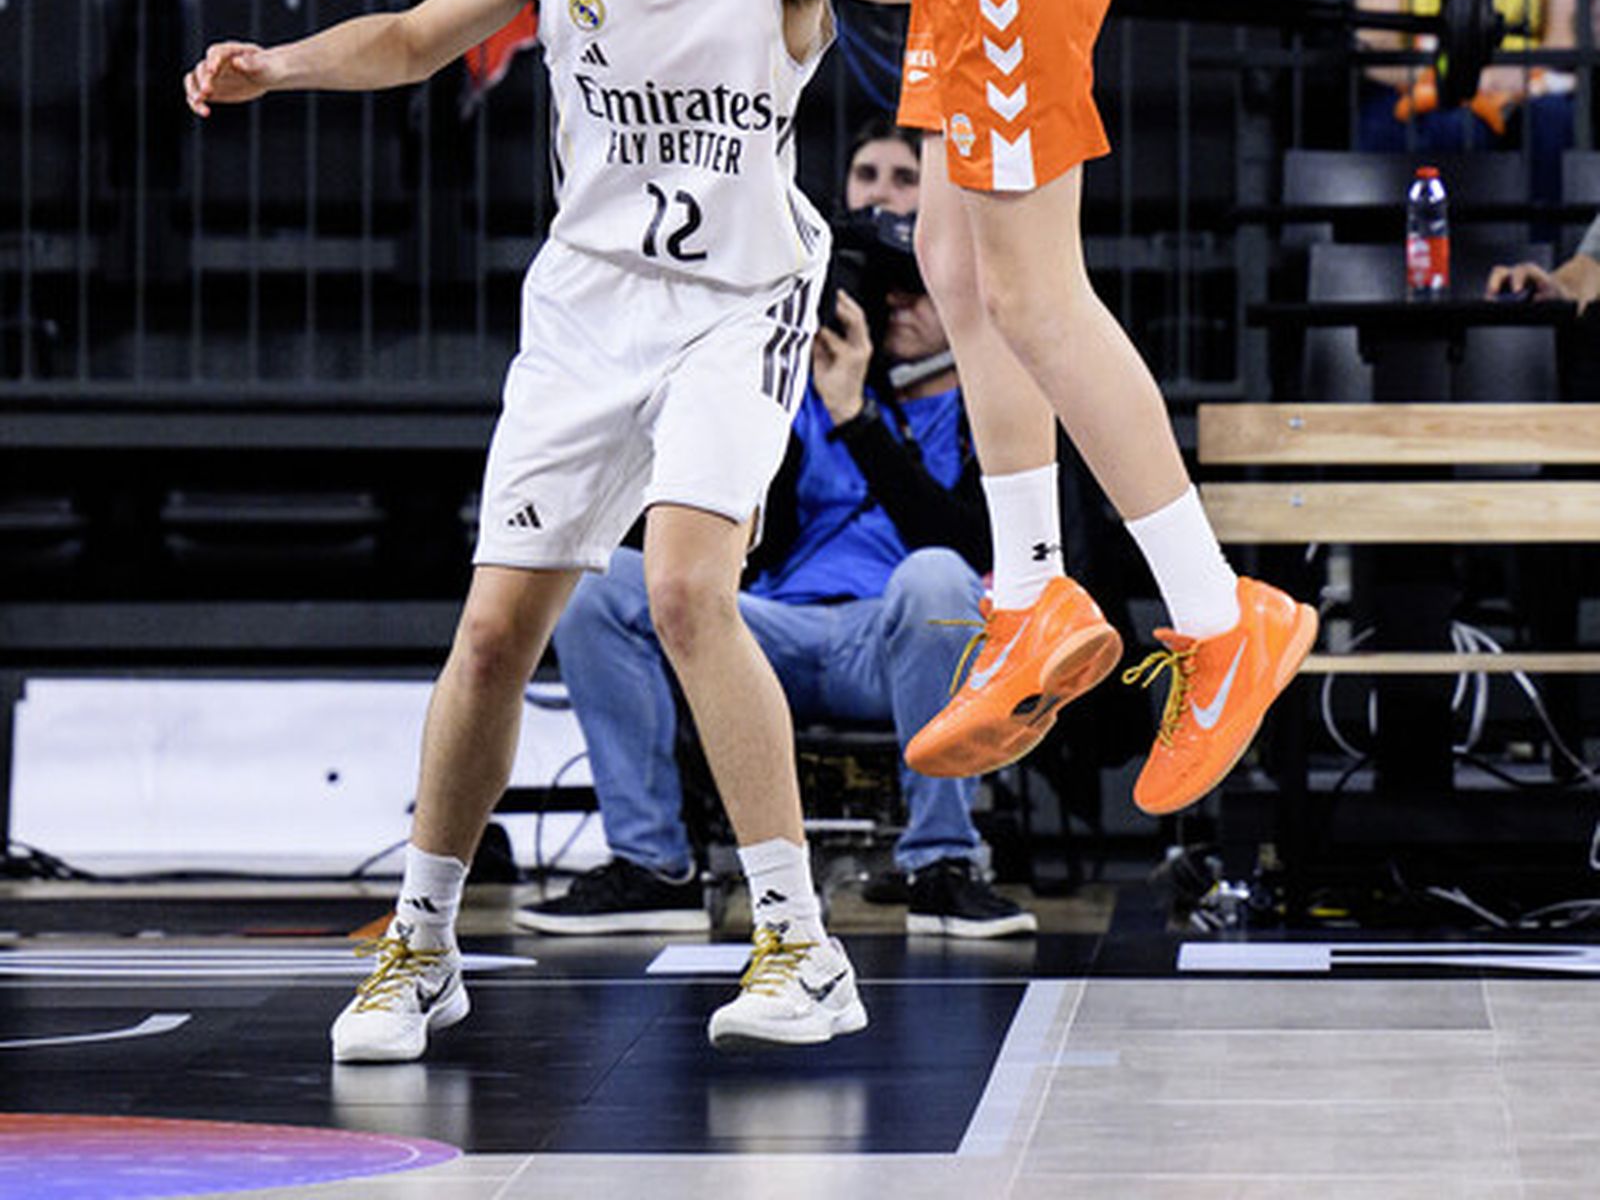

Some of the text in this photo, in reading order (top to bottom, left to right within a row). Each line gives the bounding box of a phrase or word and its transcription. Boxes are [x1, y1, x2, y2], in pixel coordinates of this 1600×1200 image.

[574, 73, 772, 130] Emirates
[659, 130, 742, 175] BETTER
[643, 182, 707, 262] 12
